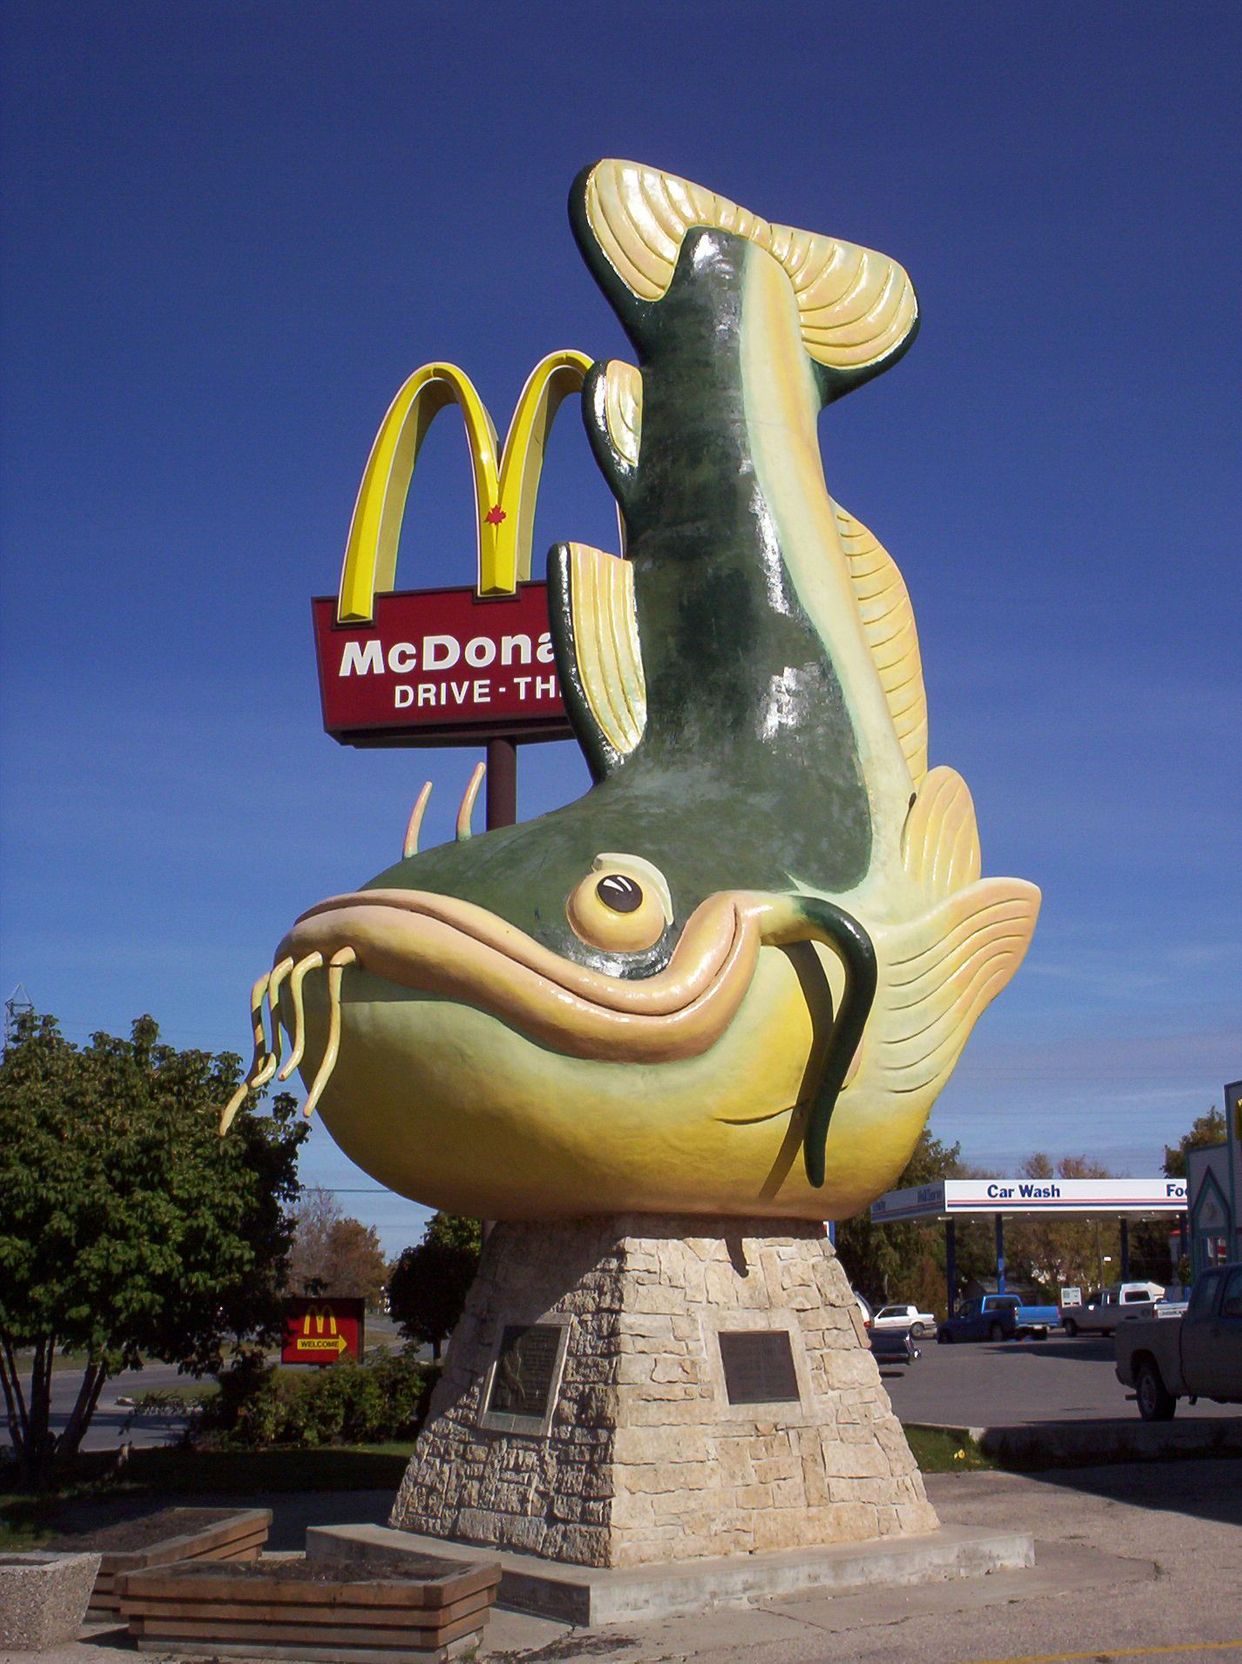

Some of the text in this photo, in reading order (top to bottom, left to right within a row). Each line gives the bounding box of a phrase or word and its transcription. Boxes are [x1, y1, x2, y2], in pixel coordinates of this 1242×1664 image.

[987, 1183, 1061, 1198] Car Wash
[301, 1340, 340, 1348] WELCOME
